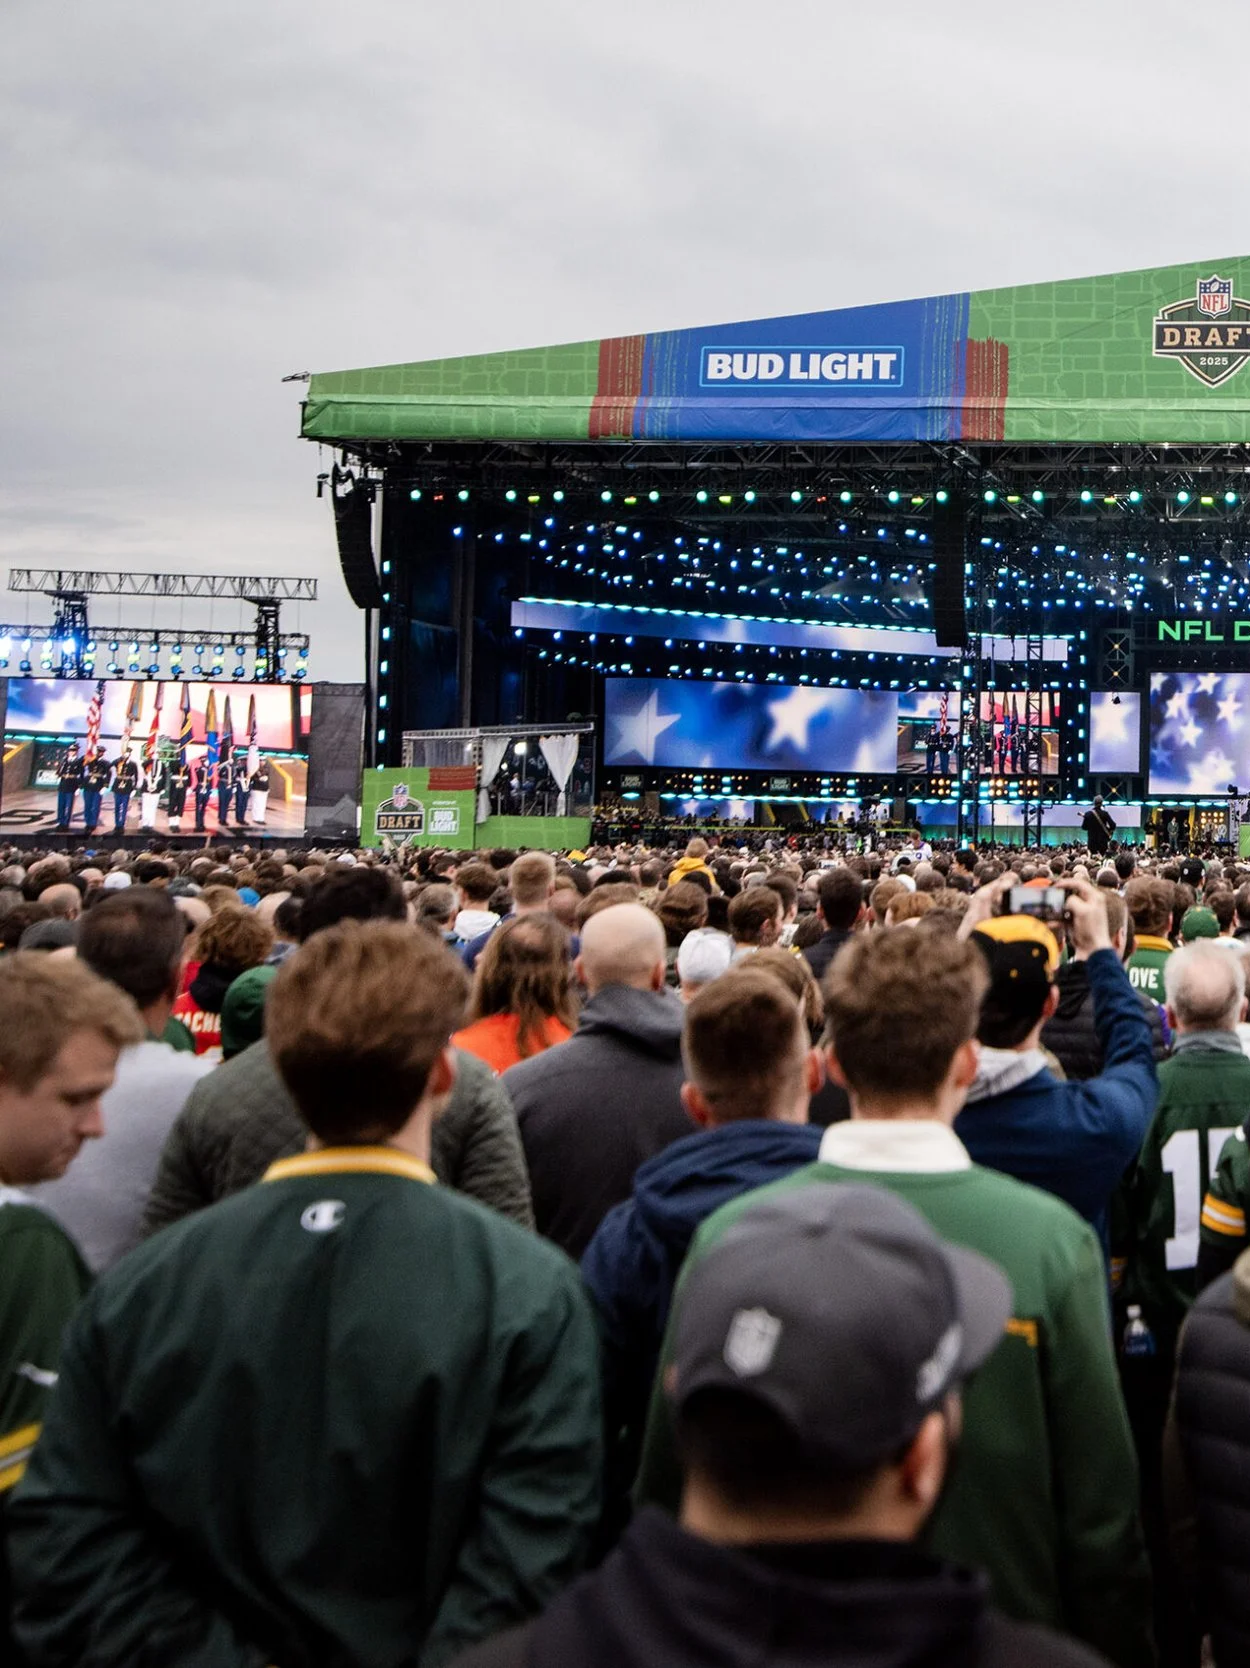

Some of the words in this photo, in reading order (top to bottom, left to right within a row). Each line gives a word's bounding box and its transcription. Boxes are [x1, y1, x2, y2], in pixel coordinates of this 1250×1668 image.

[1202, 294, 1228, 312] NFL
[707, 353, 784, 380] BUD
[789, 352, 897, 381] LIGHT
[1199, 356, 1229, 366] 2025
[1158, 620, 1224, 641] NFL
[379, 816, 421, 828] DRAFT
